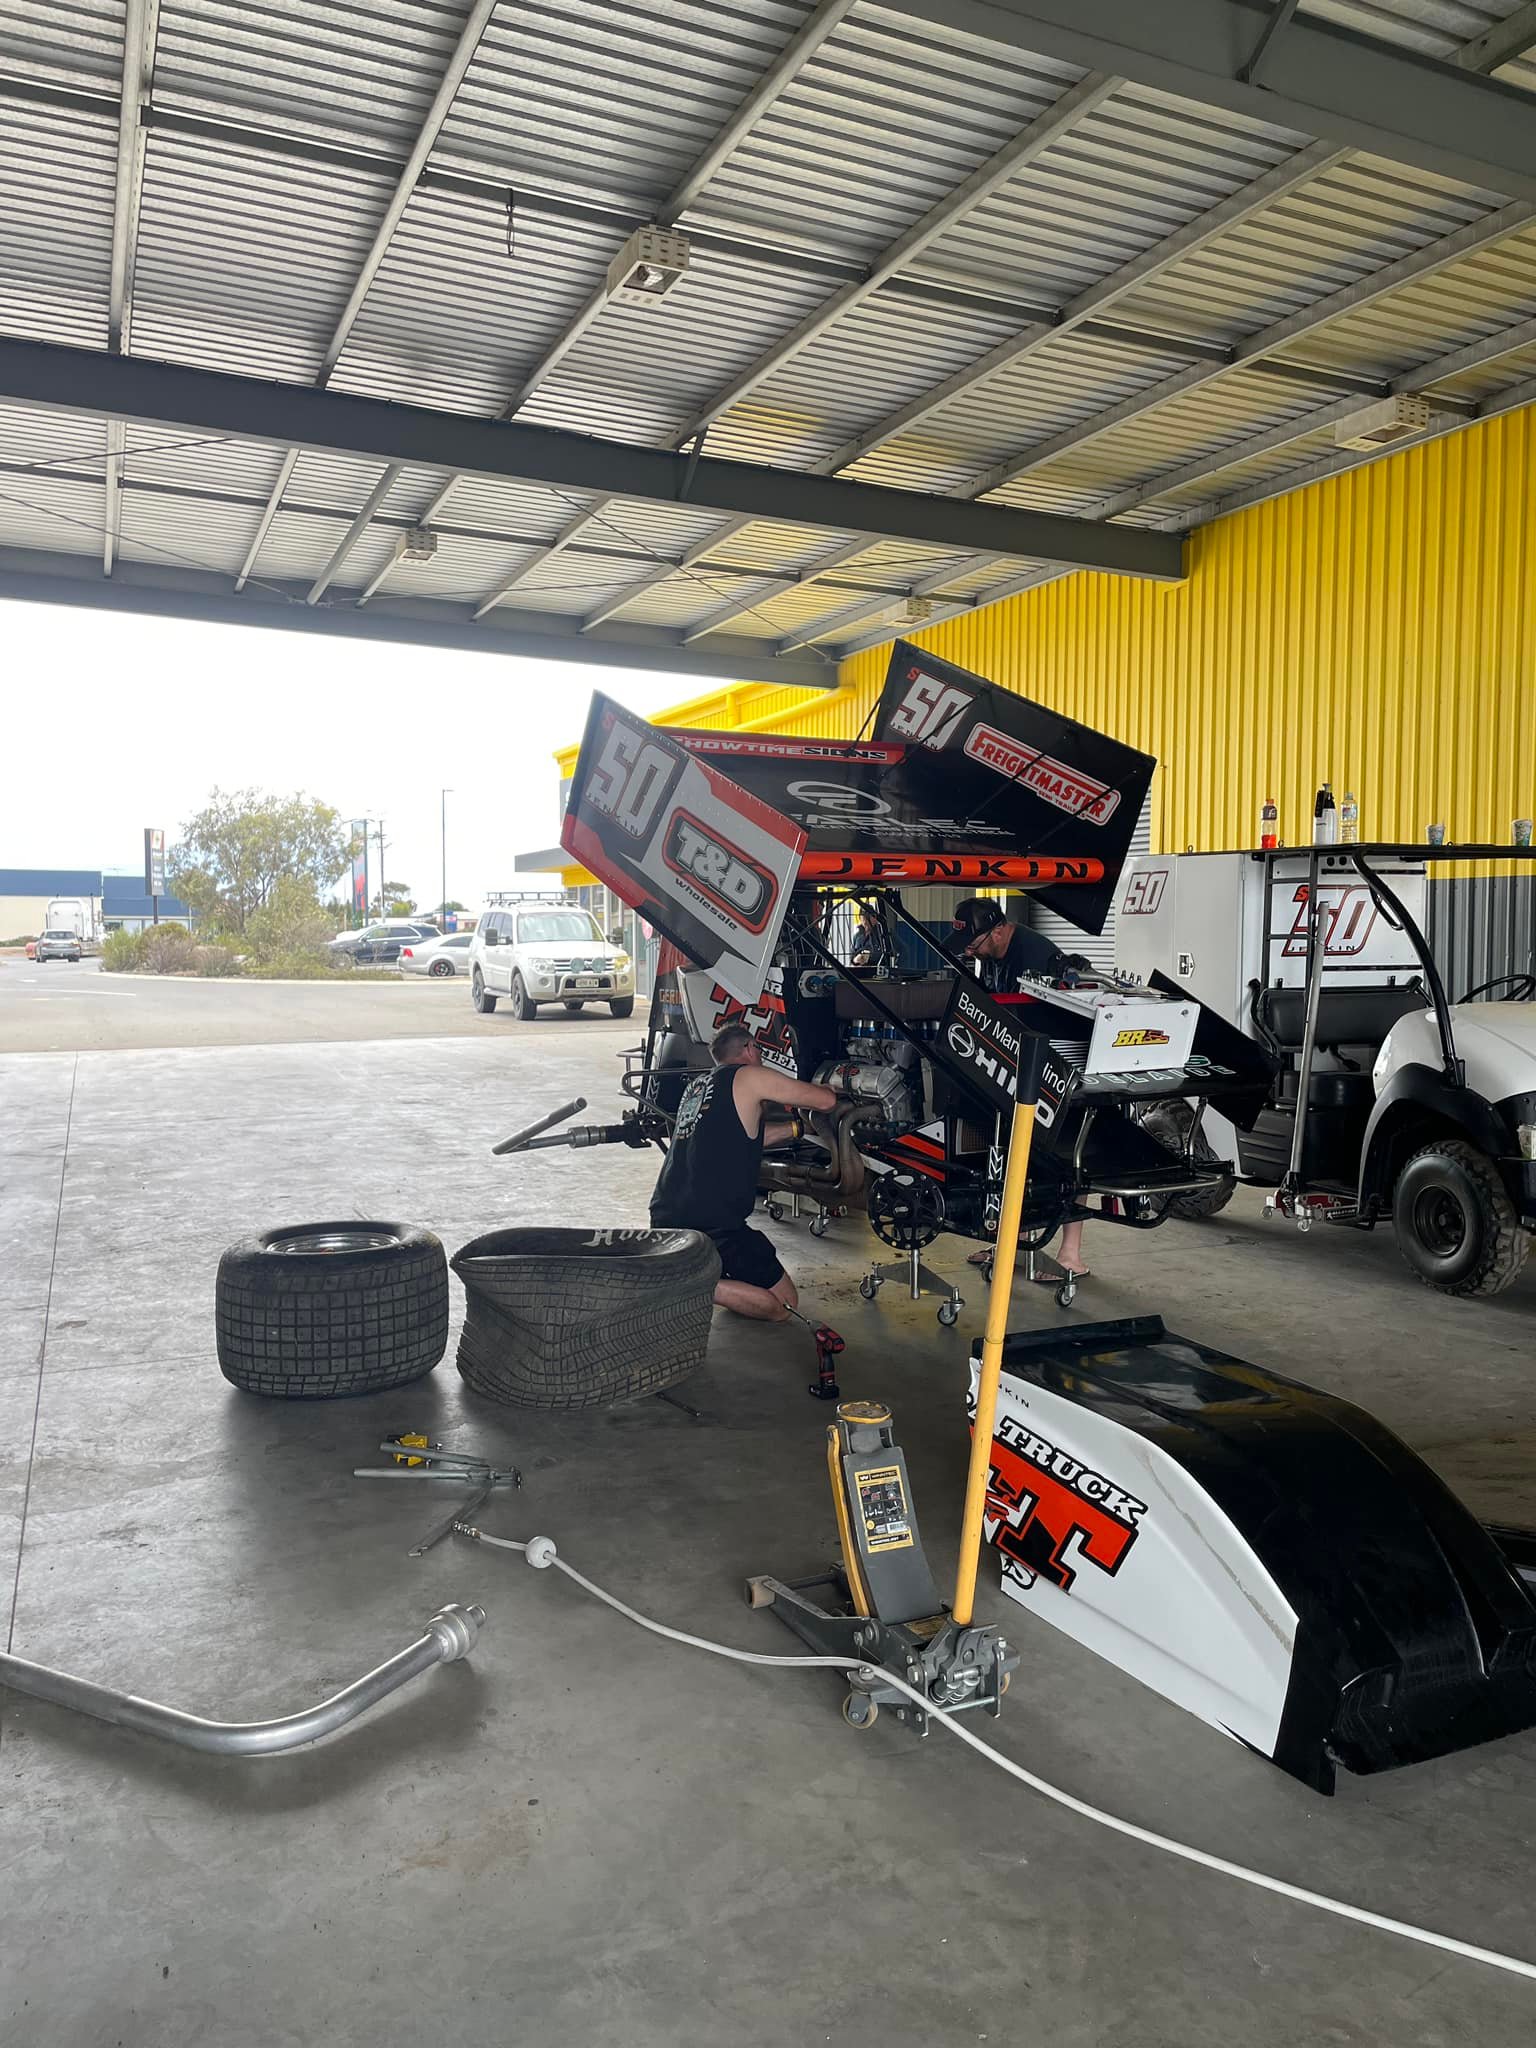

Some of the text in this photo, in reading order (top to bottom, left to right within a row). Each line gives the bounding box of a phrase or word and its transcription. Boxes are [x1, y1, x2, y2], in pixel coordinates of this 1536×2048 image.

[585, 719, 678, 838] 50
[676, 820, 765, 915] T&D
[816, 856, 1088, 879] JENKIN
[1121, 870, 1169, 915] 50
[675, 877, 739, 932] wholesale
[958, 991, 992, 1032] Barry
[1000, 1416, 1149, 1528] TRUCK
